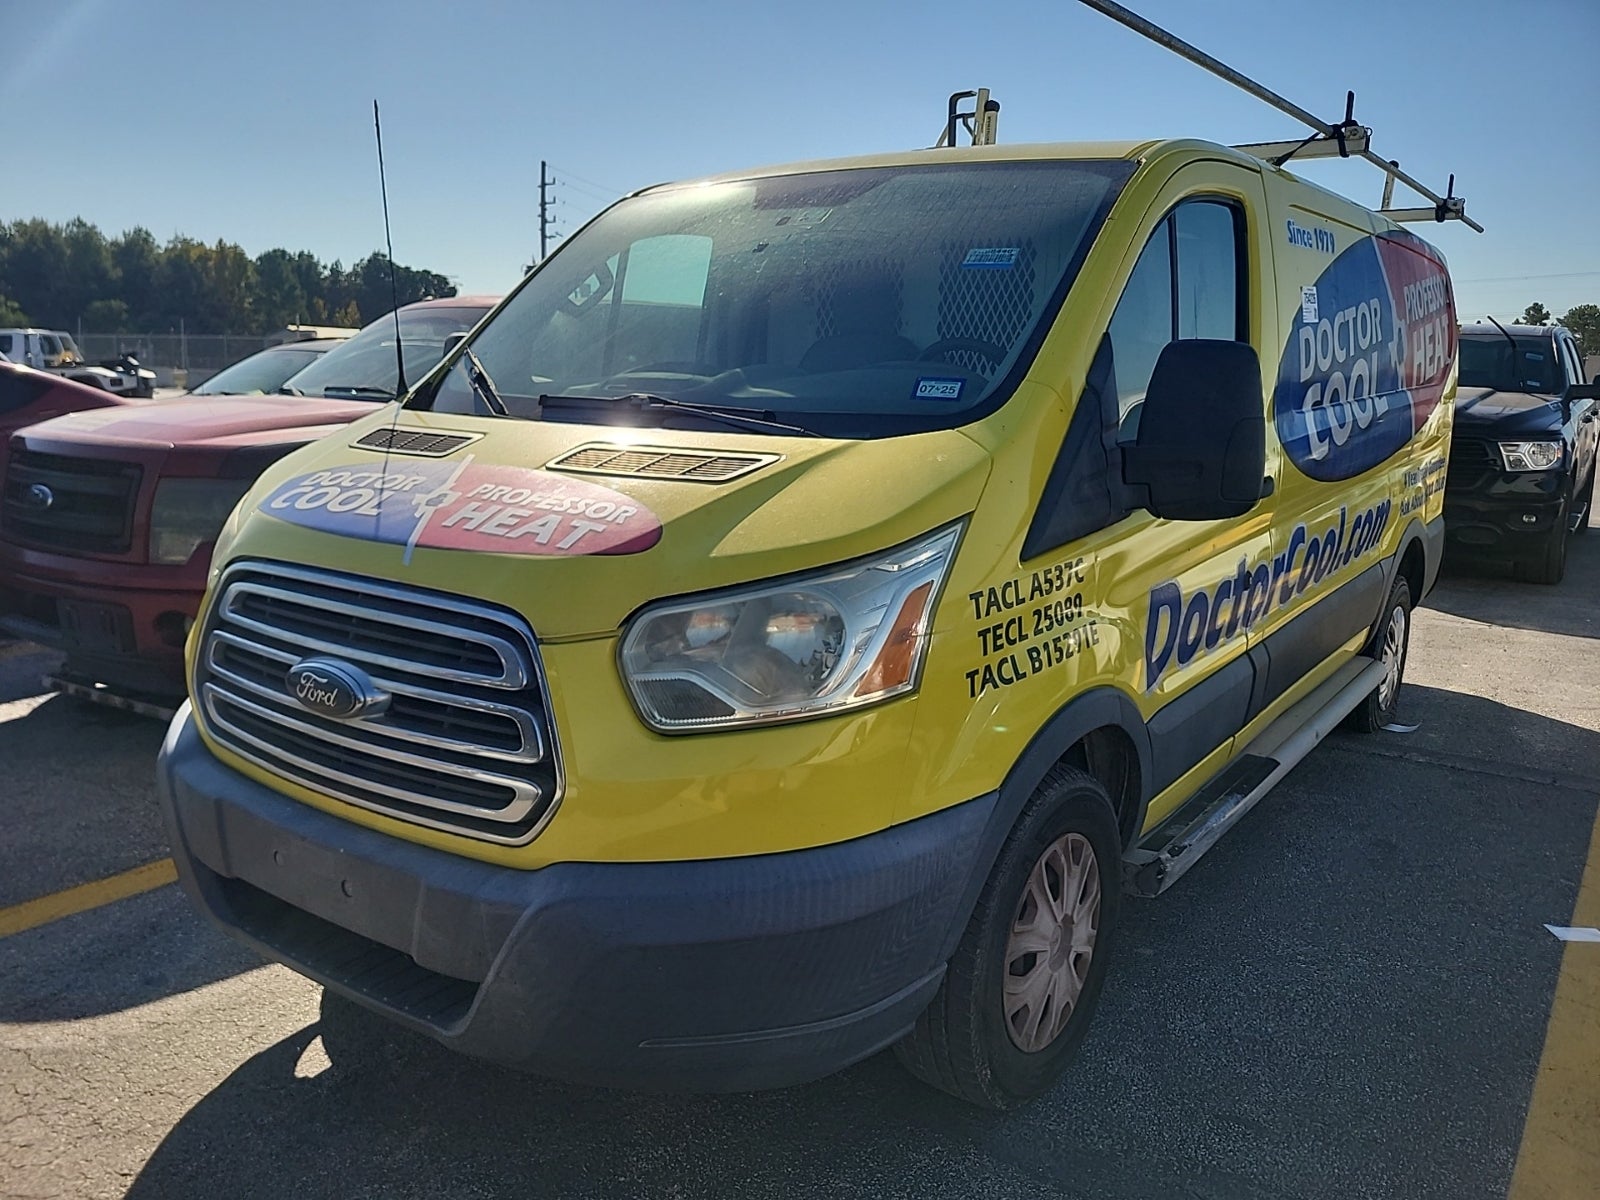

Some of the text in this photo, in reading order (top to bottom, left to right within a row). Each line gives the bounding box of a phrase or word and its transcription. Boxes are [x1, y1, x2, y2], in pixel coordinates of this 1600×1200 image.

[1287, 219, 1336, 254] Since 1979
[1298, 297, 1384, 384] DOCTOR
[1412, 312, 1450, 388] HEAT
[1302, 350, 1390, 461] COOL
[270, 487, 395, 516] COOL
[300, 471, 426, 491] DOCTOR
[466, 483, 640, 525] PROFESSOR
[440, 501, 607, 551] HEAT
[969, 557, 1085, 620] TACL A537C
[1146, 498, 1391, 693] DoctorCool.com
[977, 592, 1083, 657] TECL 25089
[296, 671, 339, 707] Ford
[965, 654, 1027, 698] TACL
